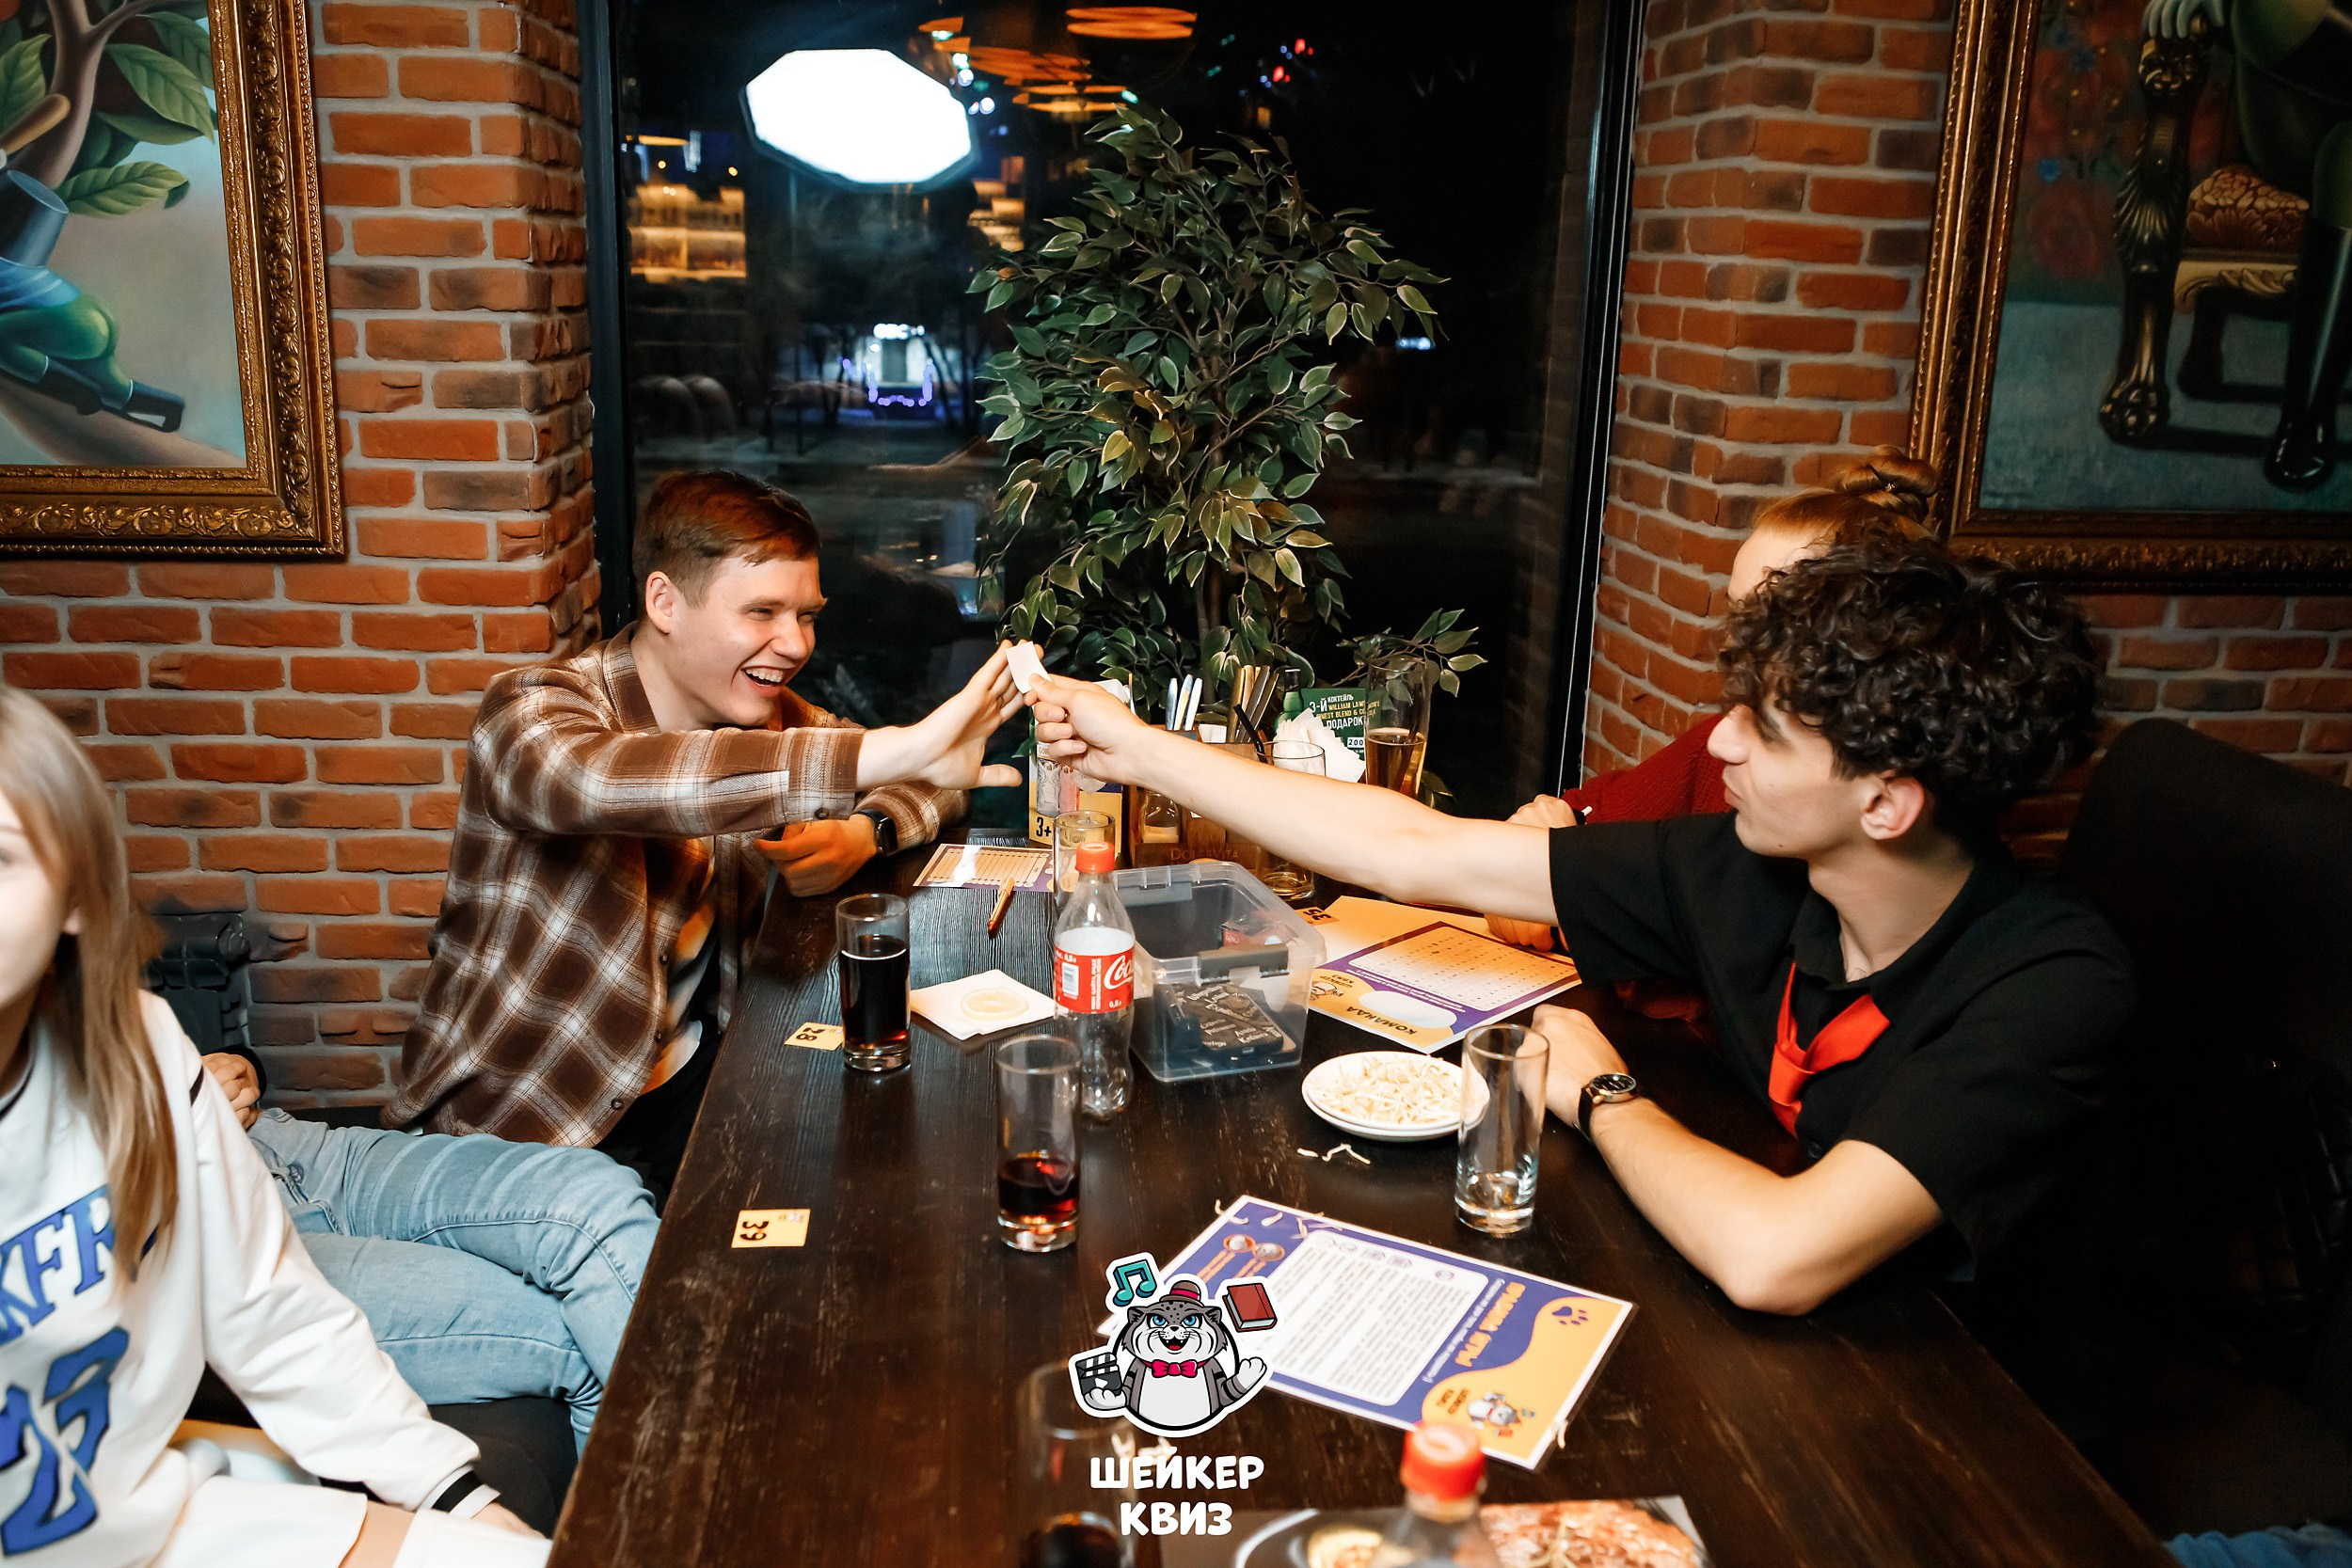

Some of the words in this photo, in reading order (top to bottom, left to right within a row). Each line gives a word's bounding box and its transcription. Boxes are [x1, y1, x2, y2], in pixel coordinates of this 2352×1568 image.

[1309, 698, 1327, 713] 3-Й
[1327, 694, 1354, 703] КОКТЕЙЛЬ
[1327, 702, 1351, 711] WILLIAM
[1326, 716, 1363, 730] ПОДАРОК
[1303, 909, 1332, 921] 35
[1346, 1006, 1418, 1035] КОМАНДА
[739, 1220, 770, 1241] 39
